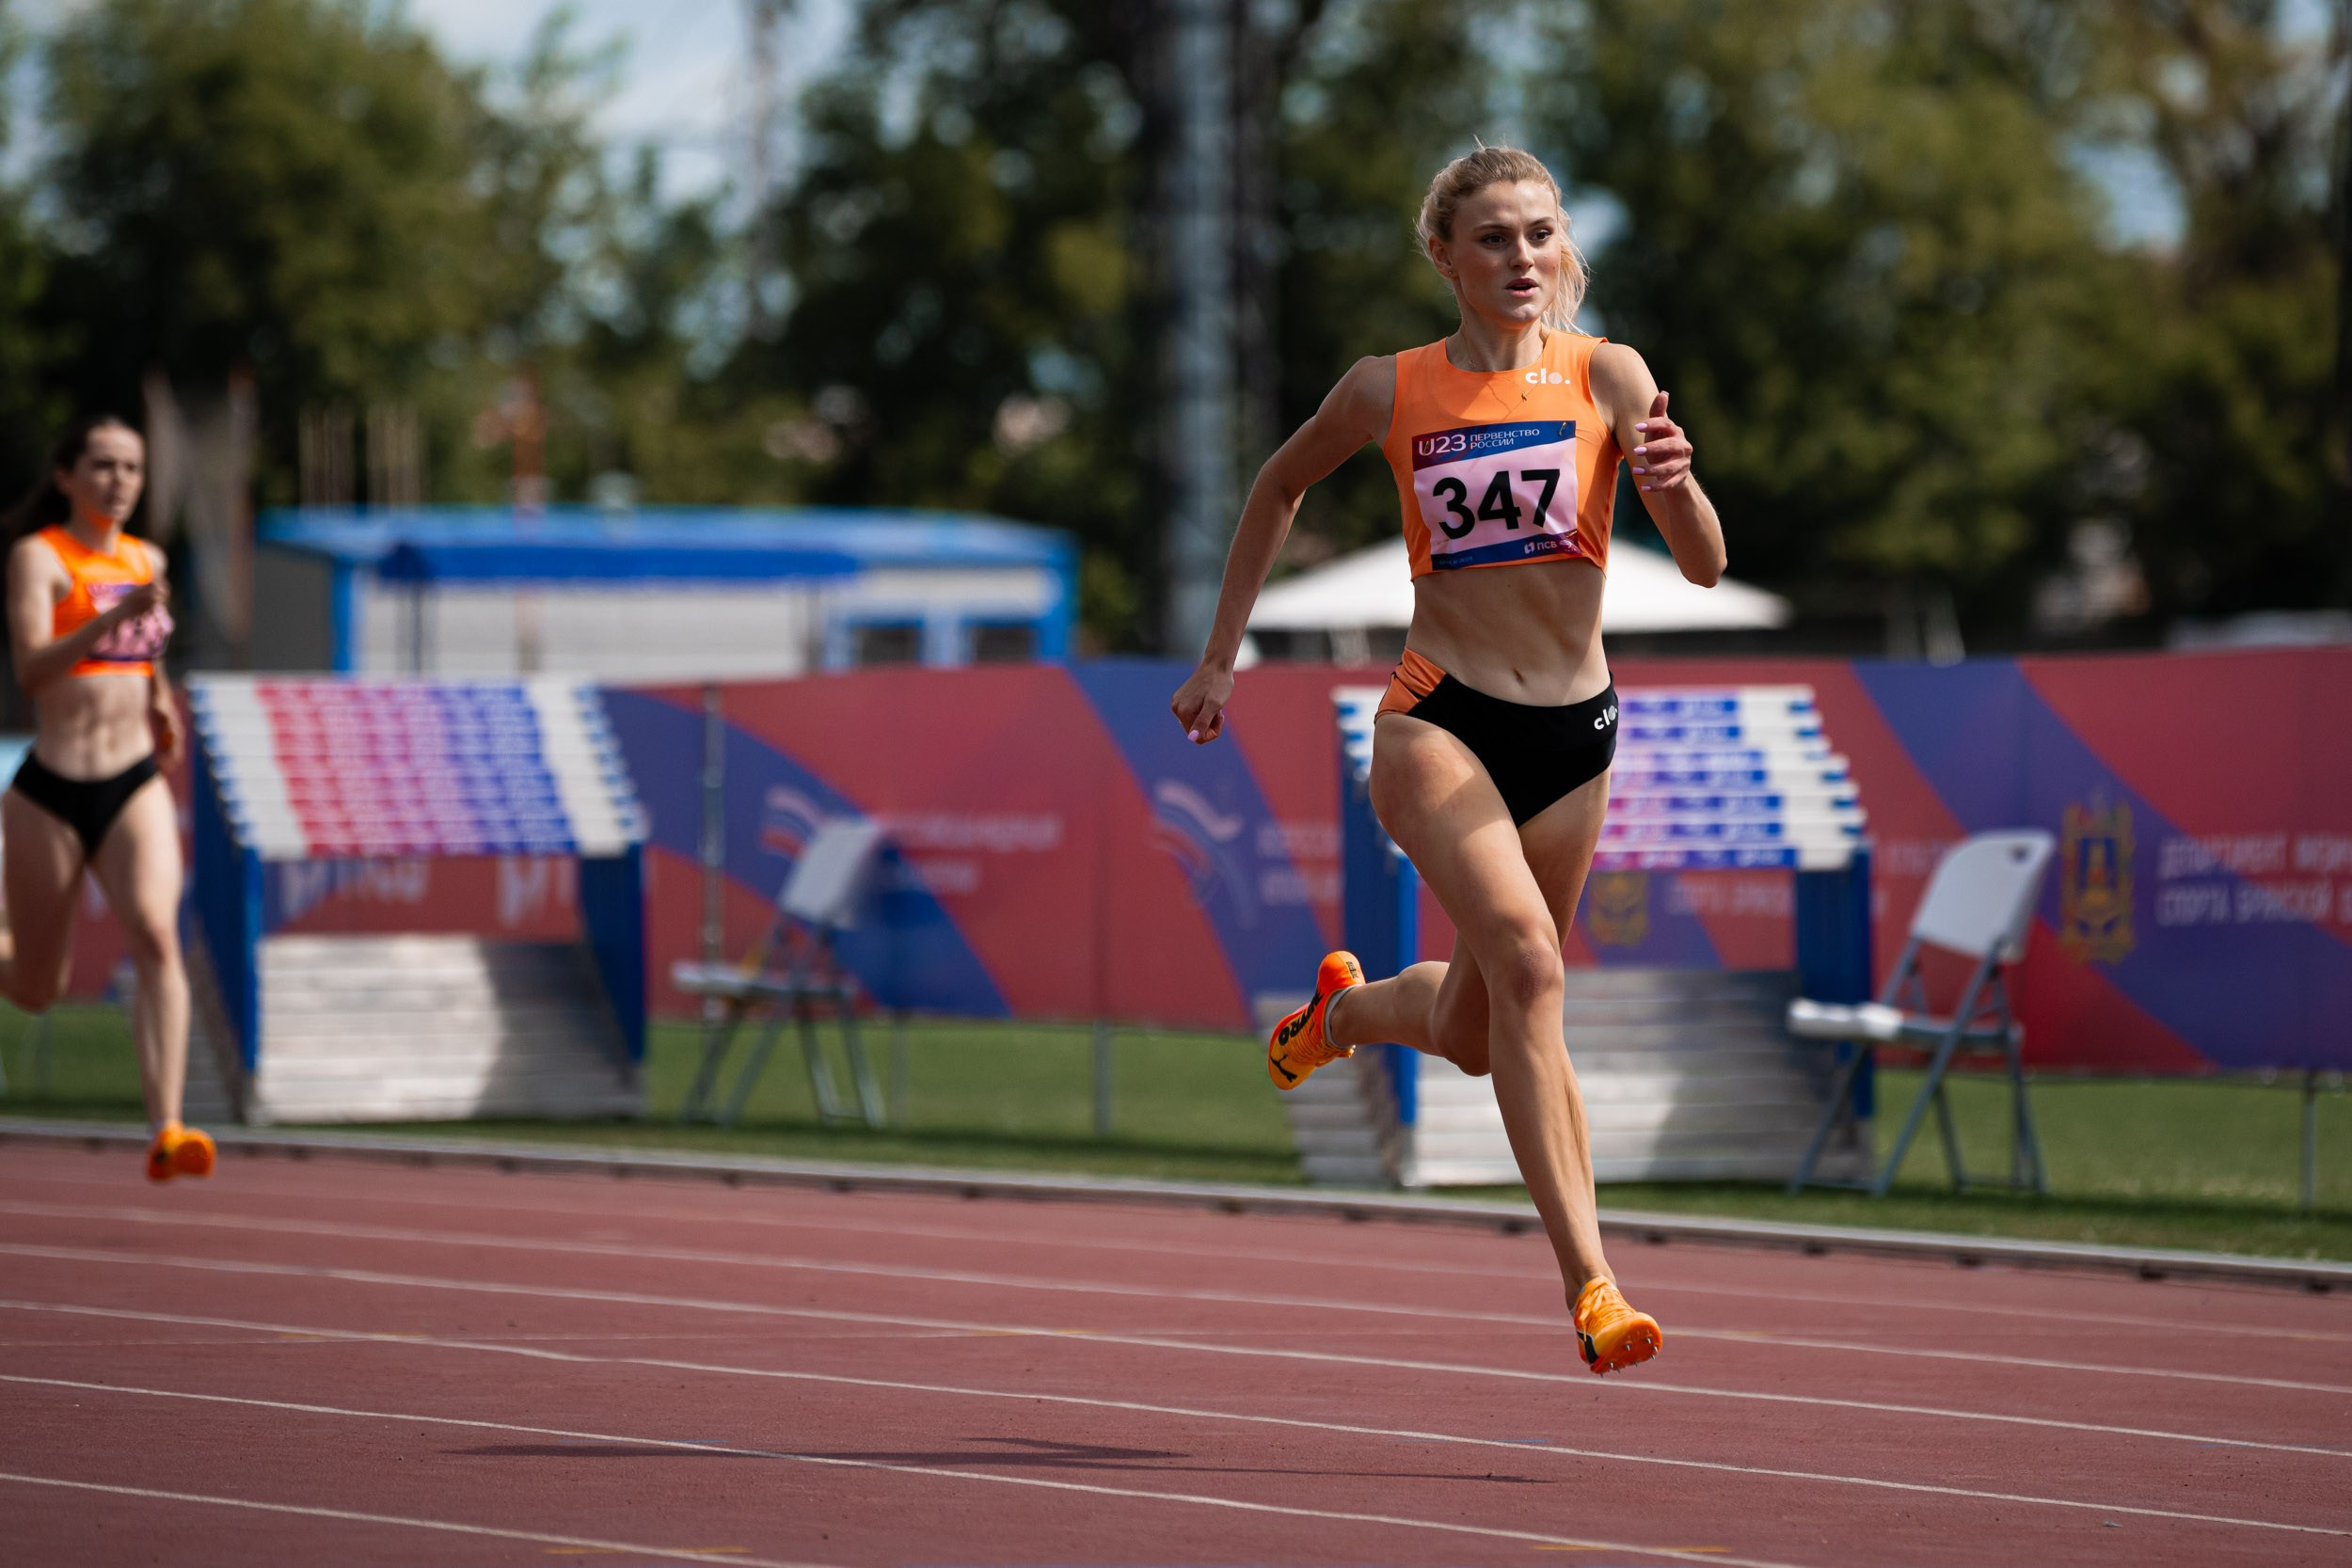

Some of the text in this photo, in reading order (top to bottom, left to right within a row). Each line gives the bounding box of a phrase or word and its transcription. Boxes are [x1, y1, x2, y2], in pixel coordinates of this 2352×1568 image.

[1525, 368, 1571, 385] clo.
[1470, 428, 1540, 441] ПЕРВЕНСТВО
[1418, 434, 1467, 456] U23
[1470, 438, 1515, 450] РОССИИ
[1432, 468, 1561, 540] 347
[1536, 541, 1558, 550] ПСБ
